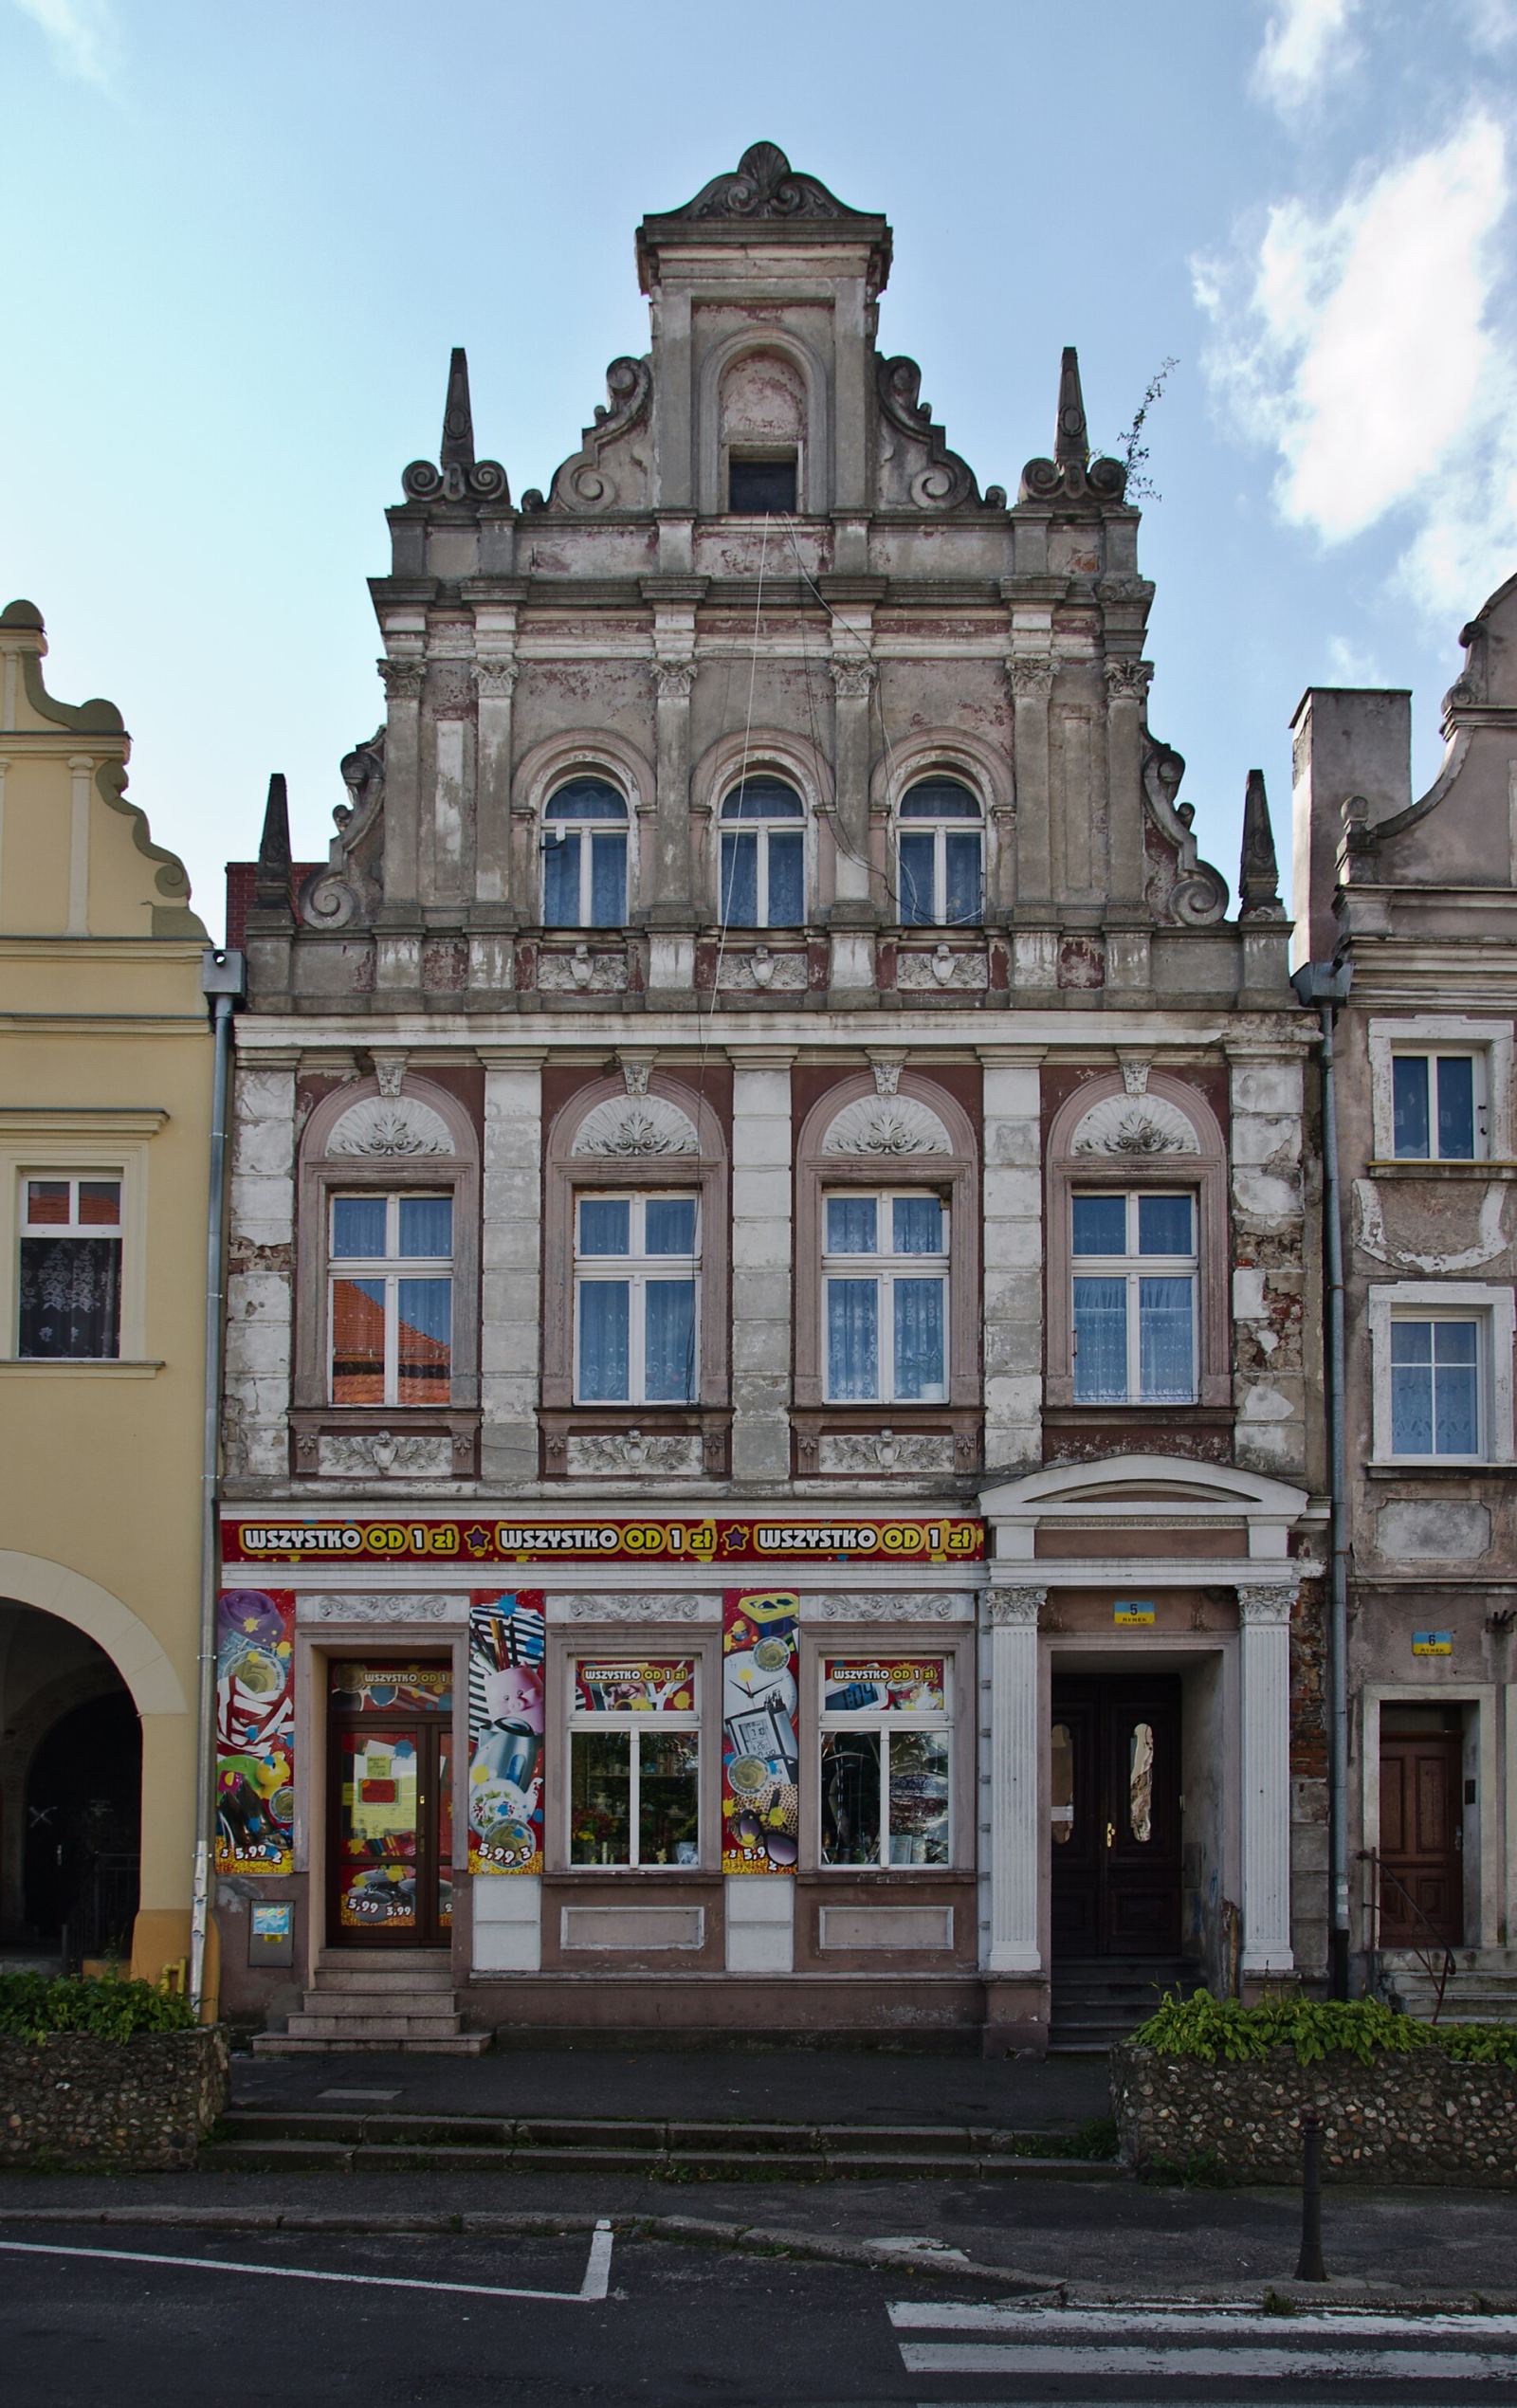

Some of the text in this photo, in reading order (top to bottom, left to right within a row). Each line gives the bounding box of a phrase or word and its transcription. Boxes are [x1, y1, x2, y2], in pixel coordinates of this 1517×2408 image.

[245, 1529, 970, 1549] WSZYSTKO OD 1 zł WSZYSTKO OD 1 zł WSZYSTKO OD 1 zł
[1130, 1603, 1138, 1615] 5
[1428, 1634, 1435, 1646] 6
[364, 1673, 447, 1683] WSZYSTKO OD 1
[585, 1670, 685, 1680] WSZYSTKO OD 1 zł
[833, 1669, 935, 1679] WSZYSTKO OD 1 zł
[235, 1844, 266, 1860] 5,99
[272, 1852, 283, 1864] 2
[478, 1842, 531, 1864] 5,99 3
[348, 1897, 411, 1917] 5,99 3,99
